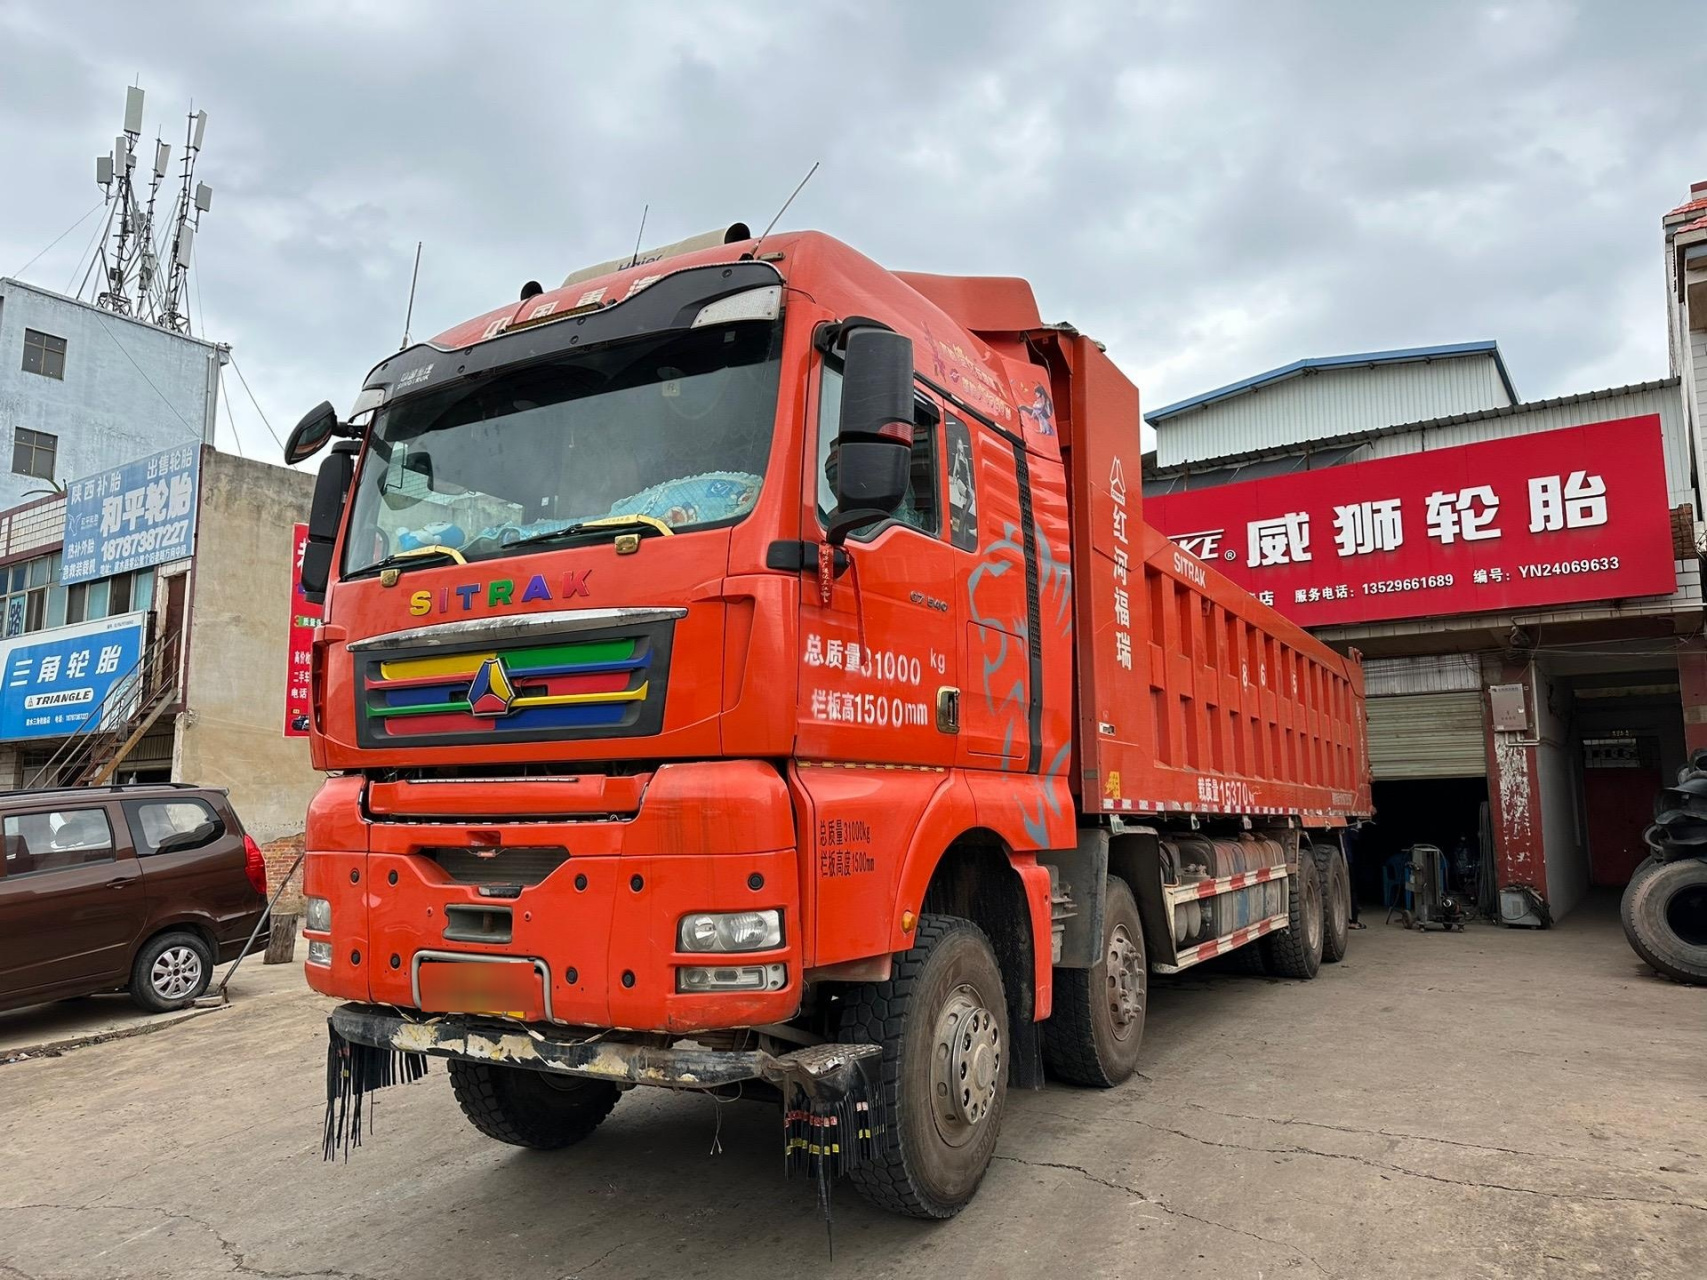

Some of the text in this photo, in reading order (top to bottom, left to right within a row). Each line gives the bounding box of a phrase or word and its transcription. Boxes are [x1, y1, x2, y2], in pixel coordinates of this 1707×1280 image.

[146, 447, 193, 480] 出售轮胎
[71, 471, 121, 505] 陕西补胎
[101, 472, 193, 537] 和平轮胎
[1246, 470, 1608, 568] 威狮轮胎
[101, 520, 189, 561] 18787387227
[1173, 551, 1207, 589] SITRAK
[1362, 573, 1454, 595] 13529661689
[1518, 556, 1620, 579] YN24069633
[409, 569, 592, 616] SITRAK
[10, 645, 122, 687] 三角轮胎
[930, 648, 946, 675] kg
[36, 690, 91, 706] TRIANGLE
[820, 819, 871, 846] 总质量31000kg
[820, 849, 875, 877] 栏板高度1500mm
